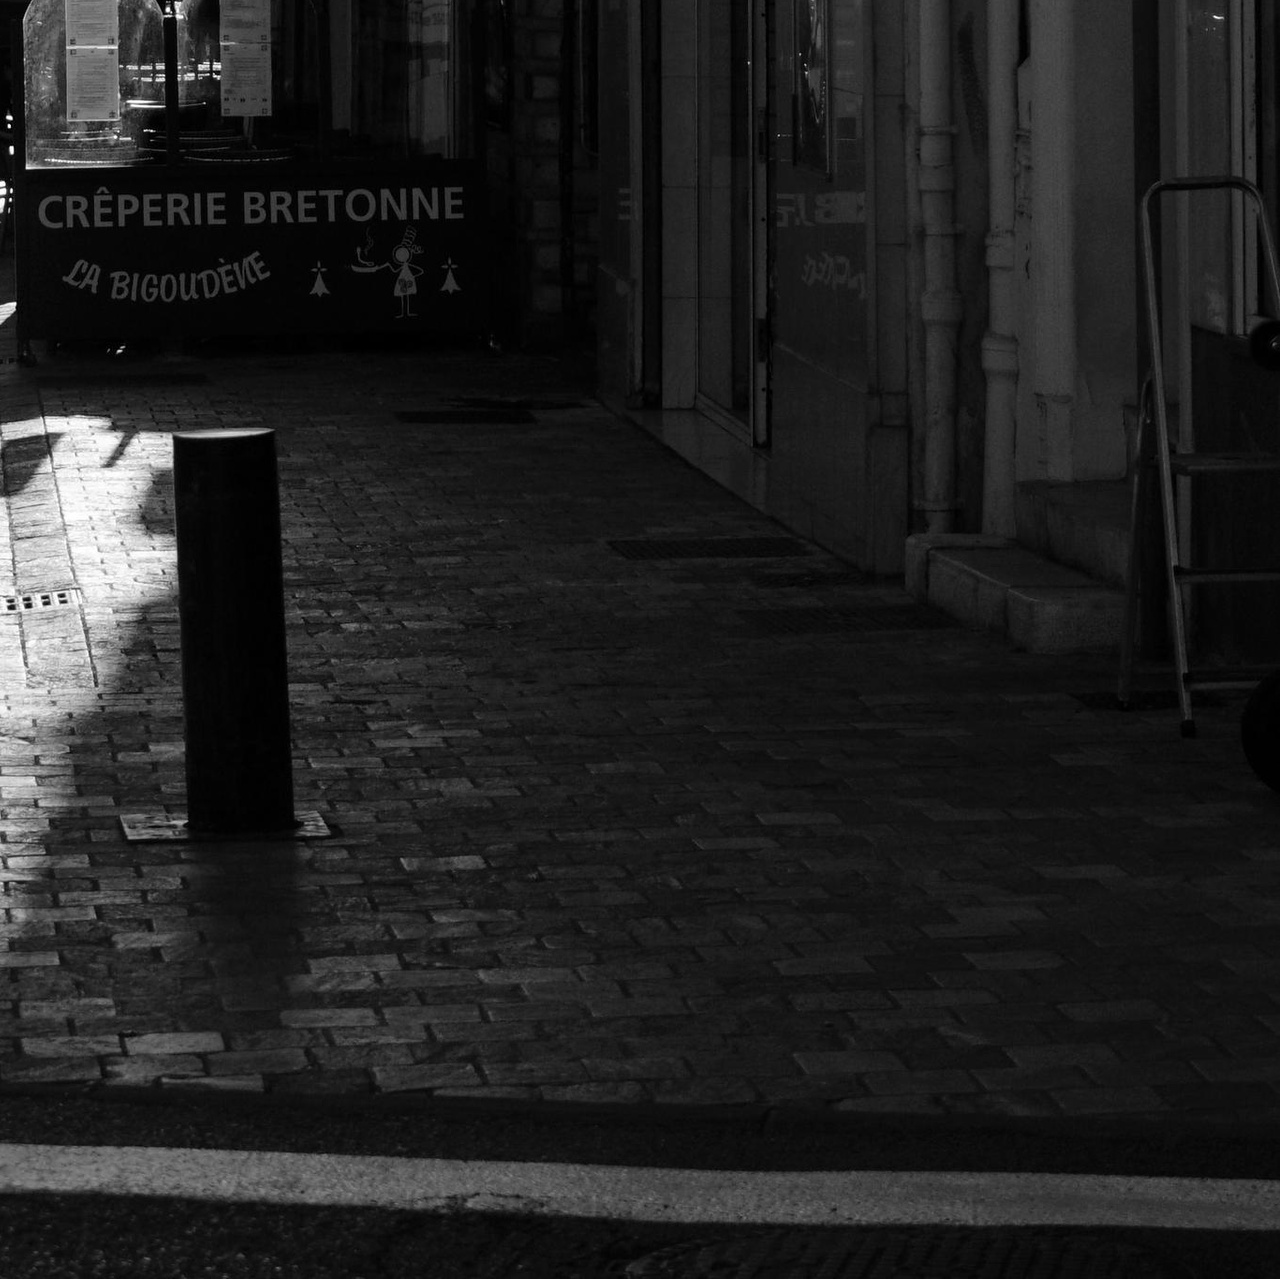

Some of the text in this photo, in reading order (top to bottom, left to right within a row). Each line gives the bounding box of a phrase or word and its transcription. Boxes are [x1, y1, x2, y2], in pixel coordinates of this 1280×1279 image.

[38, 186, 465, 229] CRÊPERIE BRETONNE
[62, 258, 104, 294] LA
